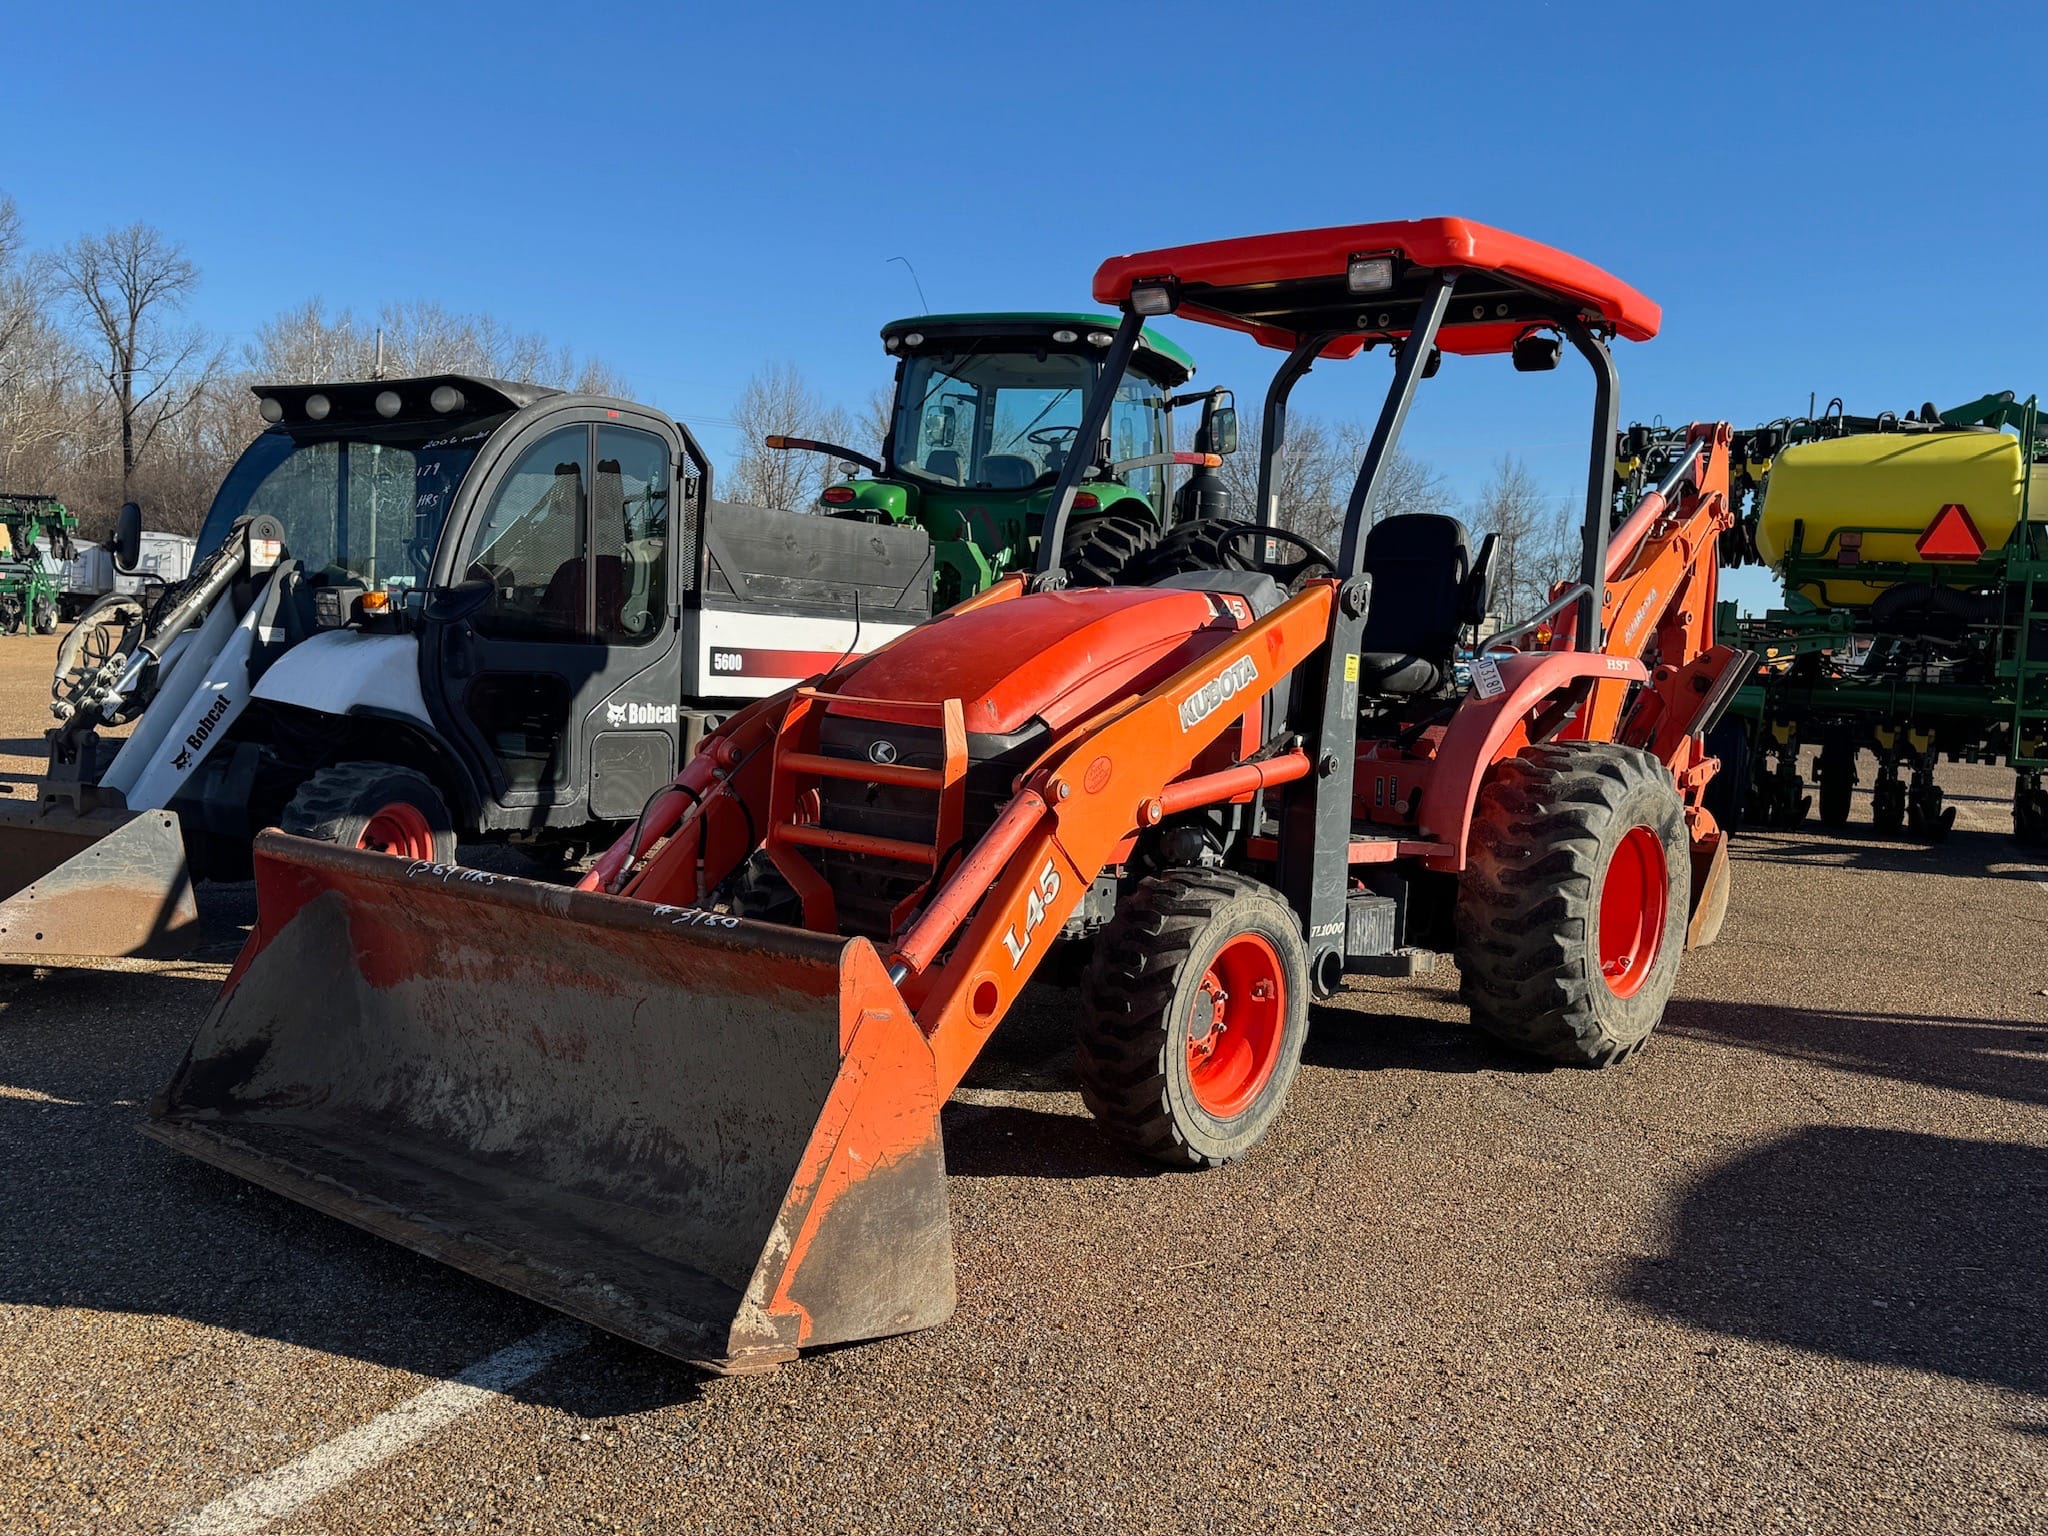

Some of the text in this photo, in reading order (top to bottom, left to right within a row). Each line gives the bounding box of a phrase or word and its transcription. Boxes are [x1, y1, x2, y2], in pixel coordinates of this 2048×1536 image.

[714, 653, 742, 671] 5600
[1607, 660, 1630, 671] HST
[1479, 661, 1503, 695] 03180
[1178, 654, 1259, 733] KUBOTA
[186, 694, 231, 752] Bobcat
[628, 703, 677, 725] Bobcat
[1002, 856, 1061, 971] L45
[1310, 921, 1344, 938] TL1000
